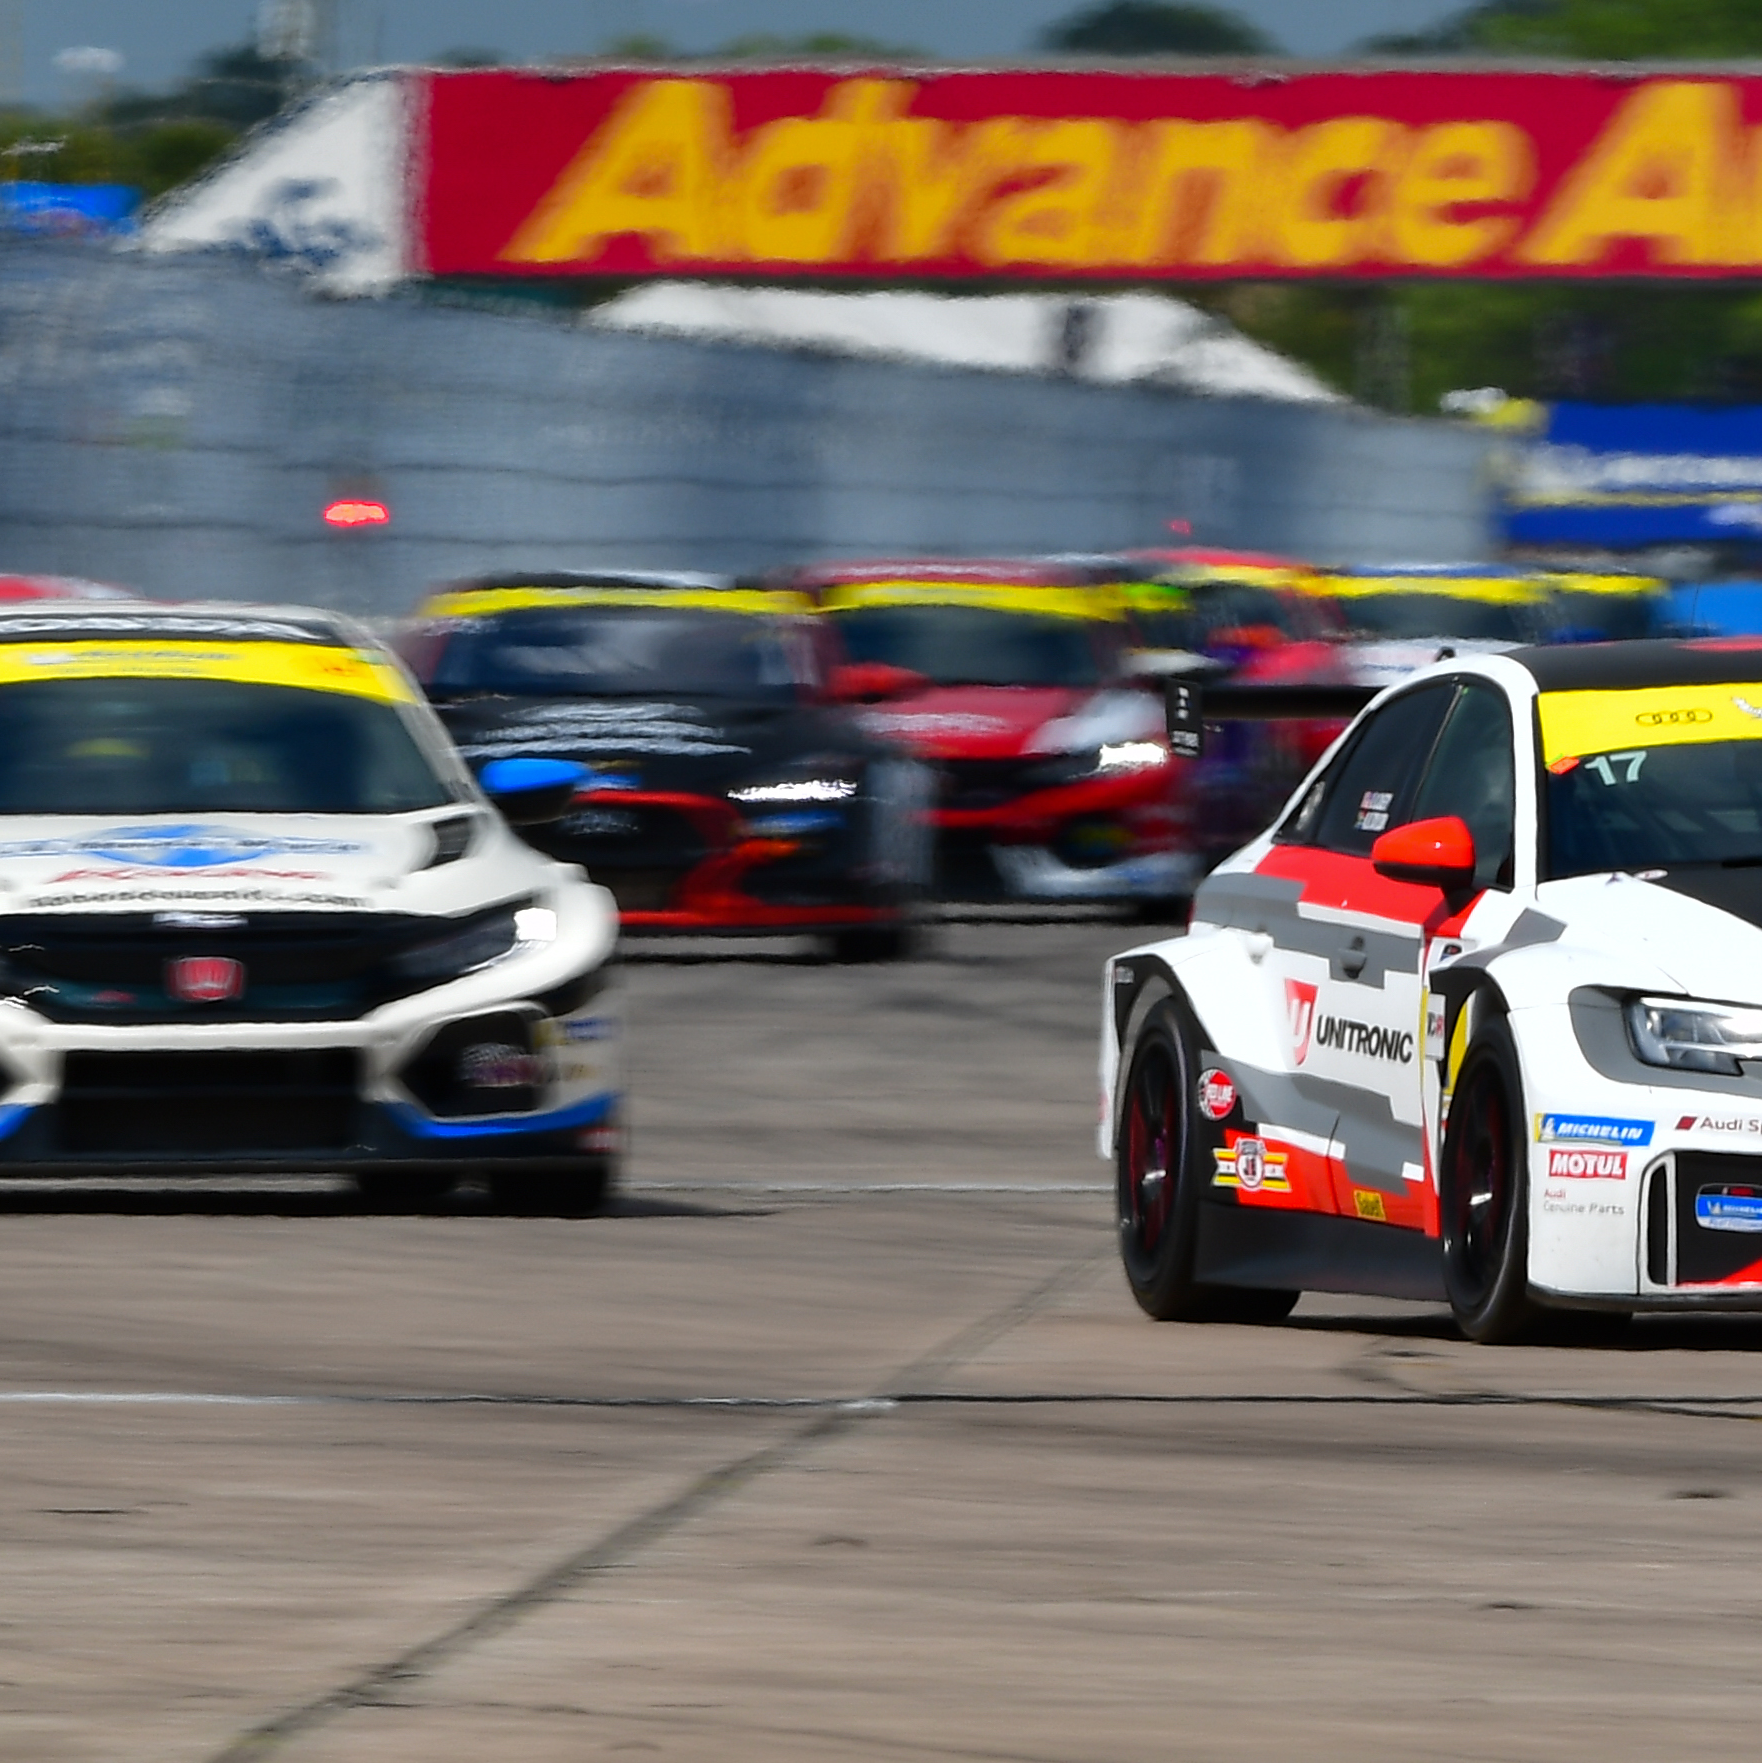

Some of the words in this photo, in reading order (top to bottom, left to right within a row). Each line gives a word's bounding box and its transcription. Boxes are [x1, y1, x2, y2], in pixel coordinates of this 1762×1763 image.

[503, 79, 1529, 266] Advance
[1584, 750, 1648, 786] 17
[1316, 1014, 1414, 1064] UNITRONIC
[1557, 1122, 1644, 1140] MICHELIN
[1700, 1117, 1743, 1131] Audi
[1550, 1153, 1623, 1175] MOTUL
[1544, 1189, 1566, 1199] Audi
[1589, 1203, 1625, 1215] Parts
